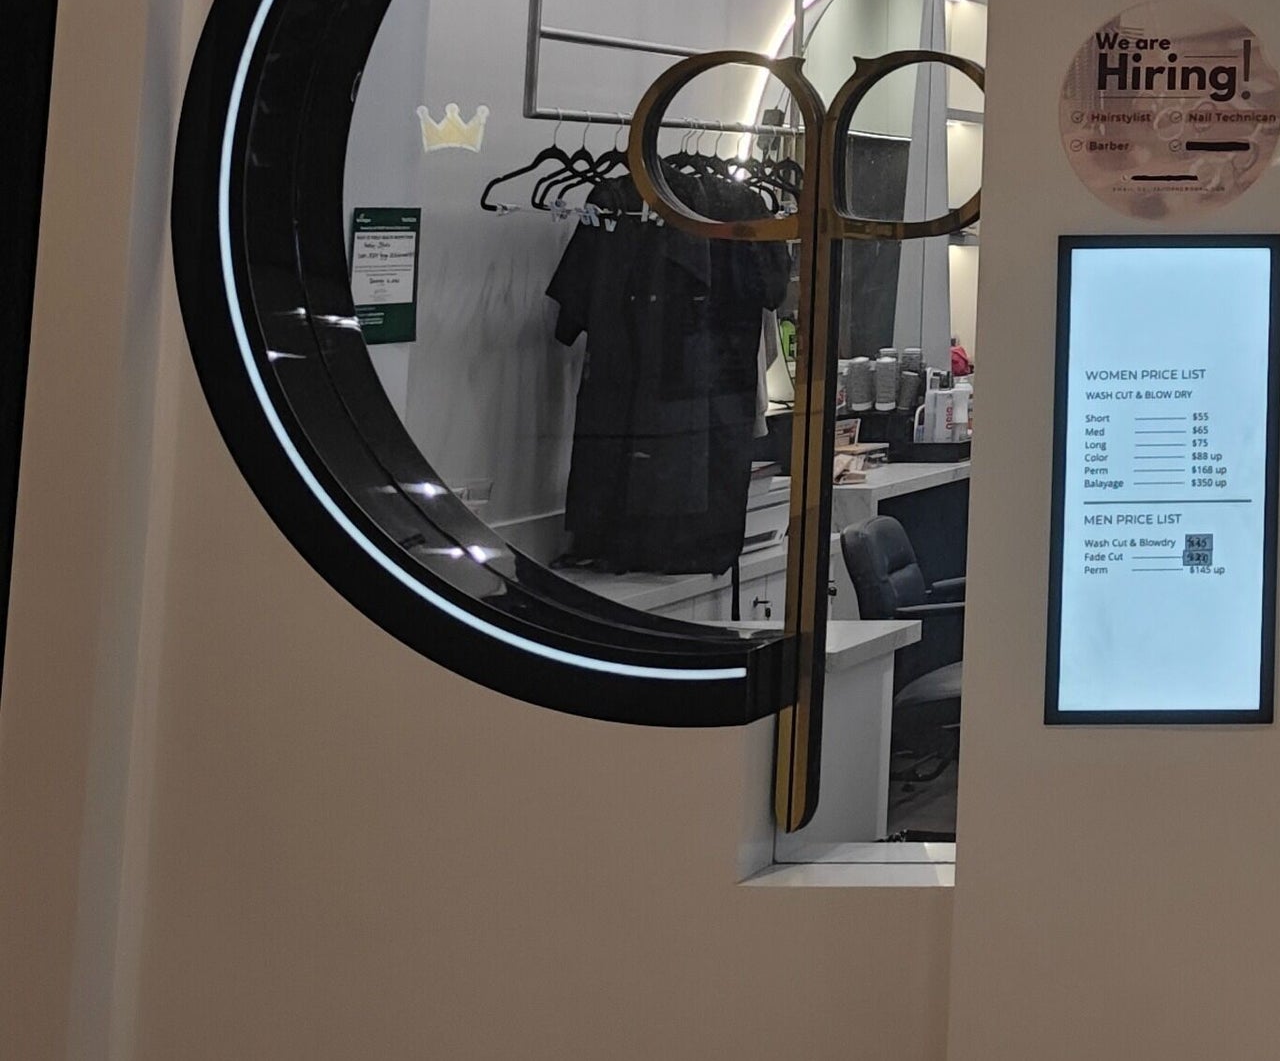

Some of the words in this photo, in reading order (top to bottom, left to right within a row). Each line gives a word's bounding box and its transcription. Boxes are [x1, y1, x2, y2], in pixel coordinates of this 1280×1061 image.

[1096, 33, 1130, 50] We
[1136, 38, 1171, 50] are
[1098, 39, 1251, 101] Hiring!
[1091, 112, 1151, 124] Hairstylist
[1188, 112, 1212, 123] Nail
[1089, 141, 1130, 151] Barber
[1086, 370, 1137, 381] WOMEN
[1141, 369, 1178, 380] PRICE
[1182, 369, 1206, 379] LIST
[1086, 391, 1113, 400] WASH
[1115, 391, 1134, 400] CUT
[1135, 391, 1143, 399] &
[1145, 391, 1172, 399] BLOW
[1174, 390, 1193, 399] DRY
[1085, 414, 1110, 423] Short
[1193, 412, 1209, 421] $55
[1085, 428, 1105, 436] Med
[1192, 426, 1209, 435] $65
[1085, 441, 1107, 451] Long
[1192, 439, 1209, 448] $75
[1085, 453, 1108, 462] Color
[1191, 452, 1209, 461] $88
[1211, 454, 1222, 463] up
[1084, 467, 1109, 475] Perm
[1215, 467, 1227, 476] up
[1084, 479, 1124, 489] Balayage
[1191, 478, 1213, 487] $350
[1215, 480, 1227, 489] up
[1084, 515, 1112, 525] MEN
[1116, 514, 1153, 524] PRICE
[1157, 514, 1182, 524] LIST
[1084, 539, 1110, 548] Wash
[1111, 539, 1128, 547] Cut
[1129, 539, 1137, 547] &
[1139, 538, 1176, 549] Blowdry
[1084, 552, 1106, 561] Fade
[1108, 552, 1123, 561] Cut
[1084, 566, 1108, 574] Perm
[1213, 567, 1225, 576] up
